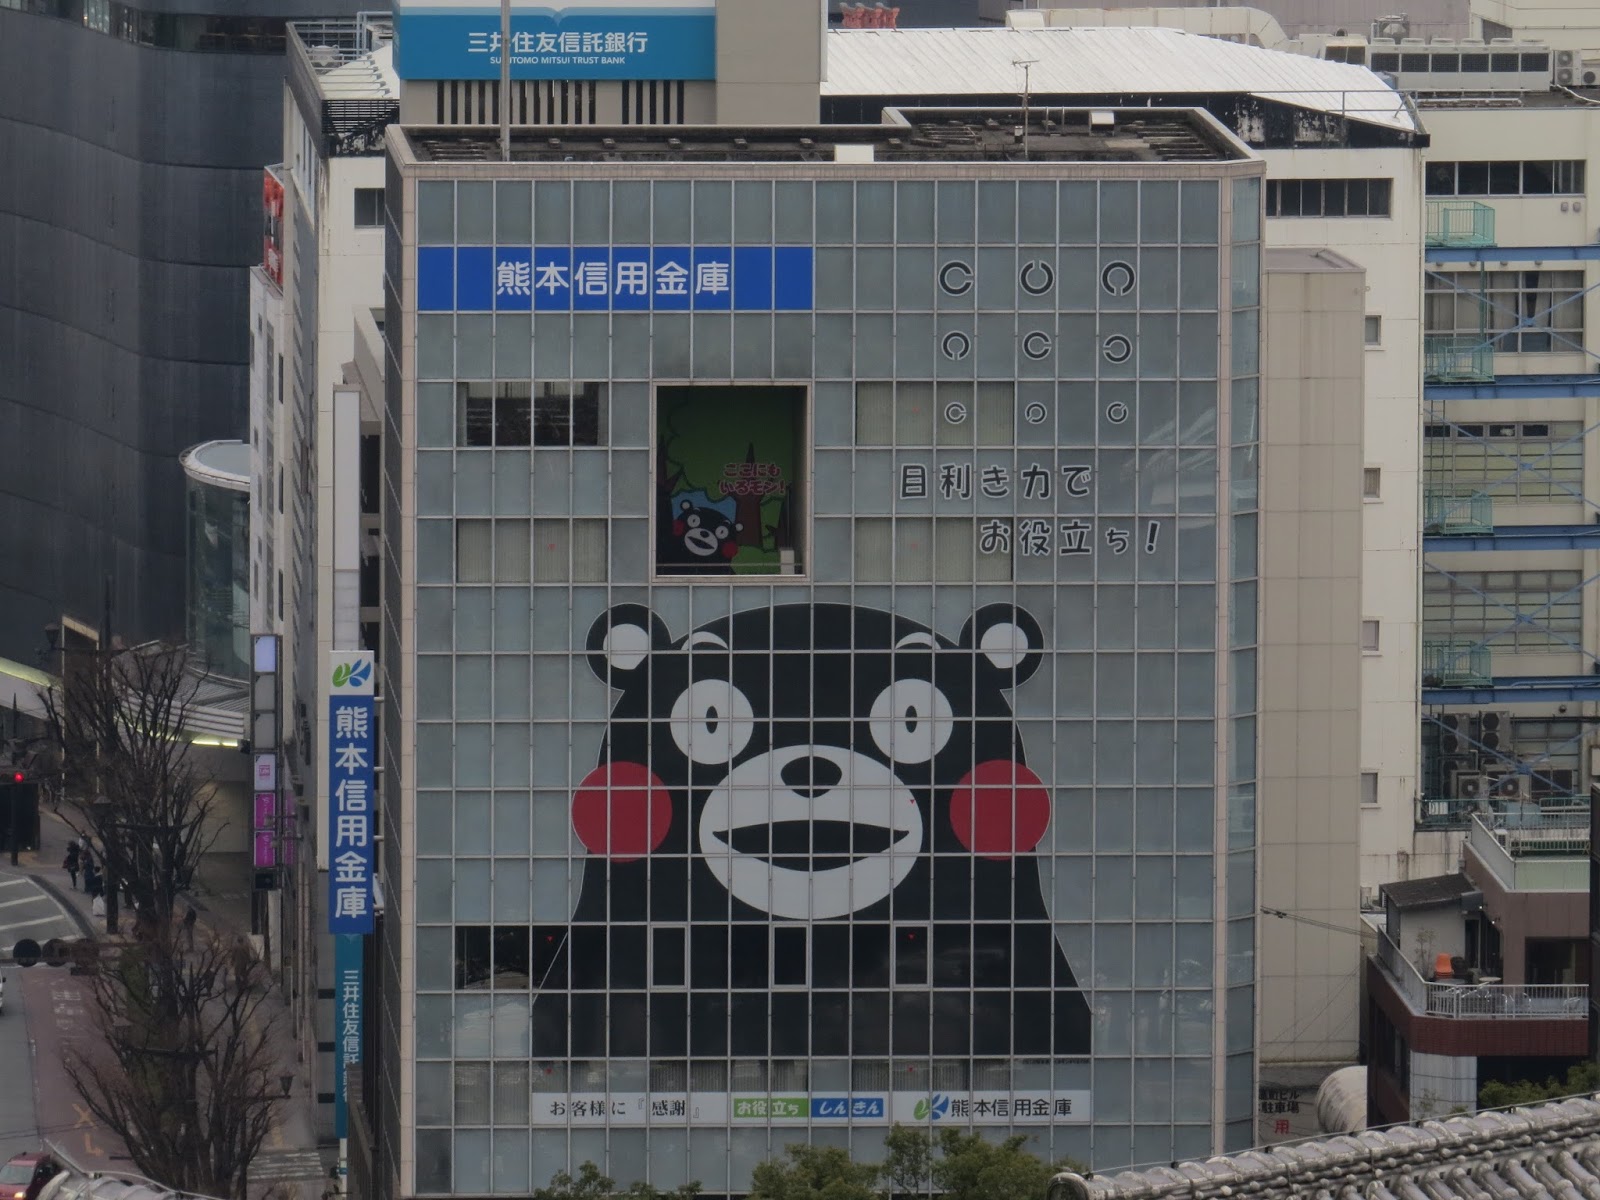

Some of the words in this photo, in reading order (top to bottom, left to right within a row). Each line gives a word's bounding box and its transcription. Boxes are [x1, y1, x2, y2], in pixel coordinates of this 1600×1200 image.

[468, 31, 648, 53] 三井住友信託銀行
[490, 56, 538, 64] SUITOMO
[541, 56, 570, 64] MITSUI
[573, 56, 598, 64] TRUST
[601, 56, 625, 64] BANK
[496, 261, 730, 296] 熊本信用金庫
[901, 463, 1092, 500] 目利き力で
[980, 519, 1160, 556] お役立ち!
[335, 706, 368, 919] 熊本信用金庫
[342, 969, 360, 1102] 三井住友信託
[737, 1100, 799, 1116] お役立ち
[818, 1100, 880, 1115] しんきん
[951, 1098, 1072, 1117] 熊本信用金庫
